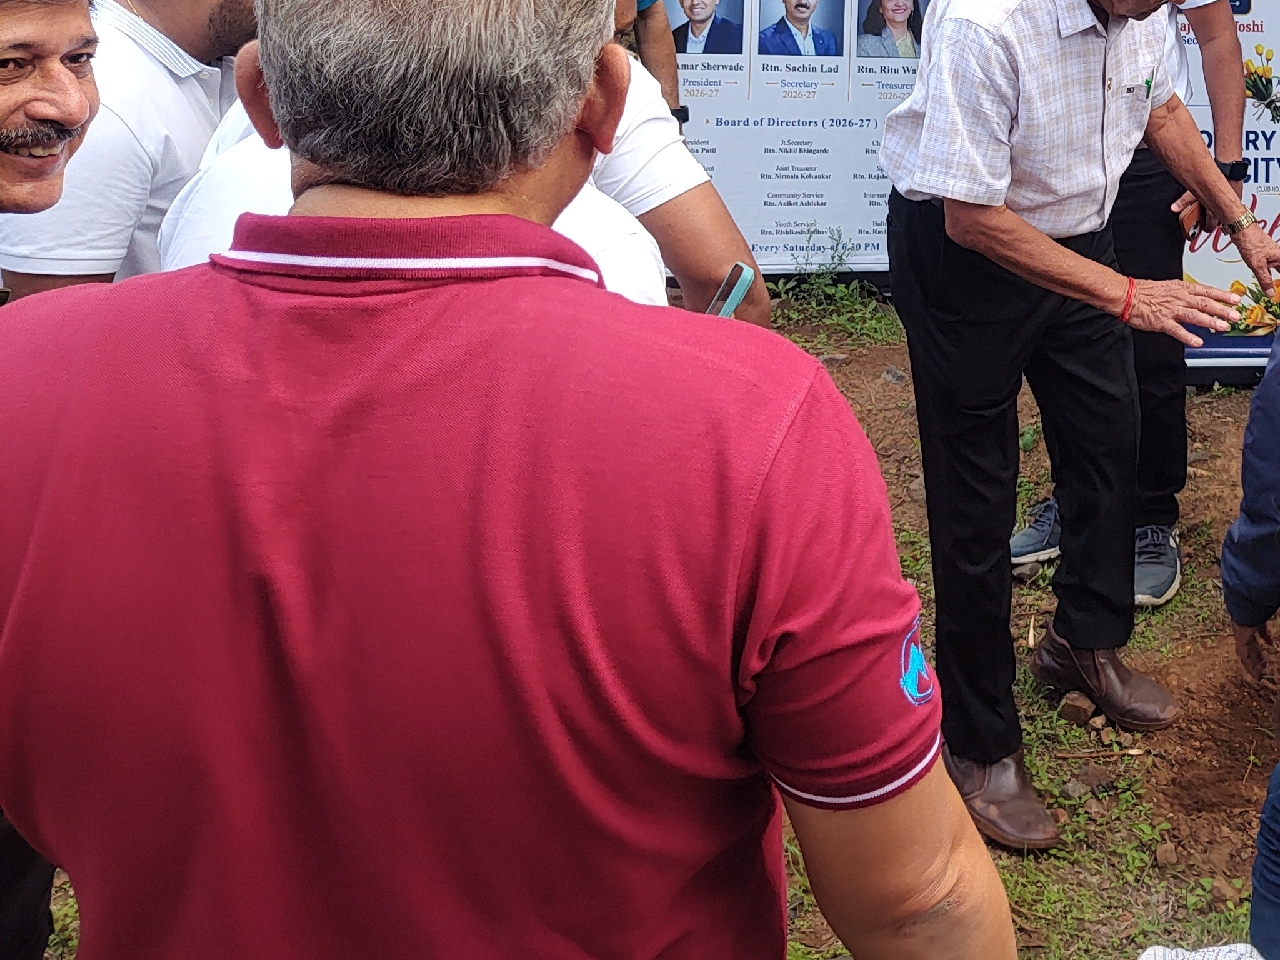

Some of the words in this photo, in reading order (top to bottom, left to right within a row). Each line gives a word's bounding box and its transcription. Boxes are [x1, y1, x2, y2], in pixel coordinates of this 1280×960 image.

[761, 63, 783, 72] Rtn.
[785, 63, 817, 73] Sachin
[820, 65, 839, 74] Lad
[857, 65, 877, 75] Rtn.
[880, 66, 900, 75] Ritu
[682, 78, 722, 87] President
[780, 79, 820, 89] Secretary
[876, 81, 914, 89] Treasurer
[683, 89, 720, 98] 2026-27
[782, 91, 817, 99] 2026-27
[715, 117, 749, 127] Board
[753, 117, 764, 127] of
[767, 118, 818, 127] Directors
[829, 118, 872, 128] 2026-27
[767, 192, 801, 200] Community
[775, 220, 792, 228] Youth
[751, 243, 781, 254] Every
[782, 243, 826, 253] Saturday
[864, 243, 880, 251] PM
